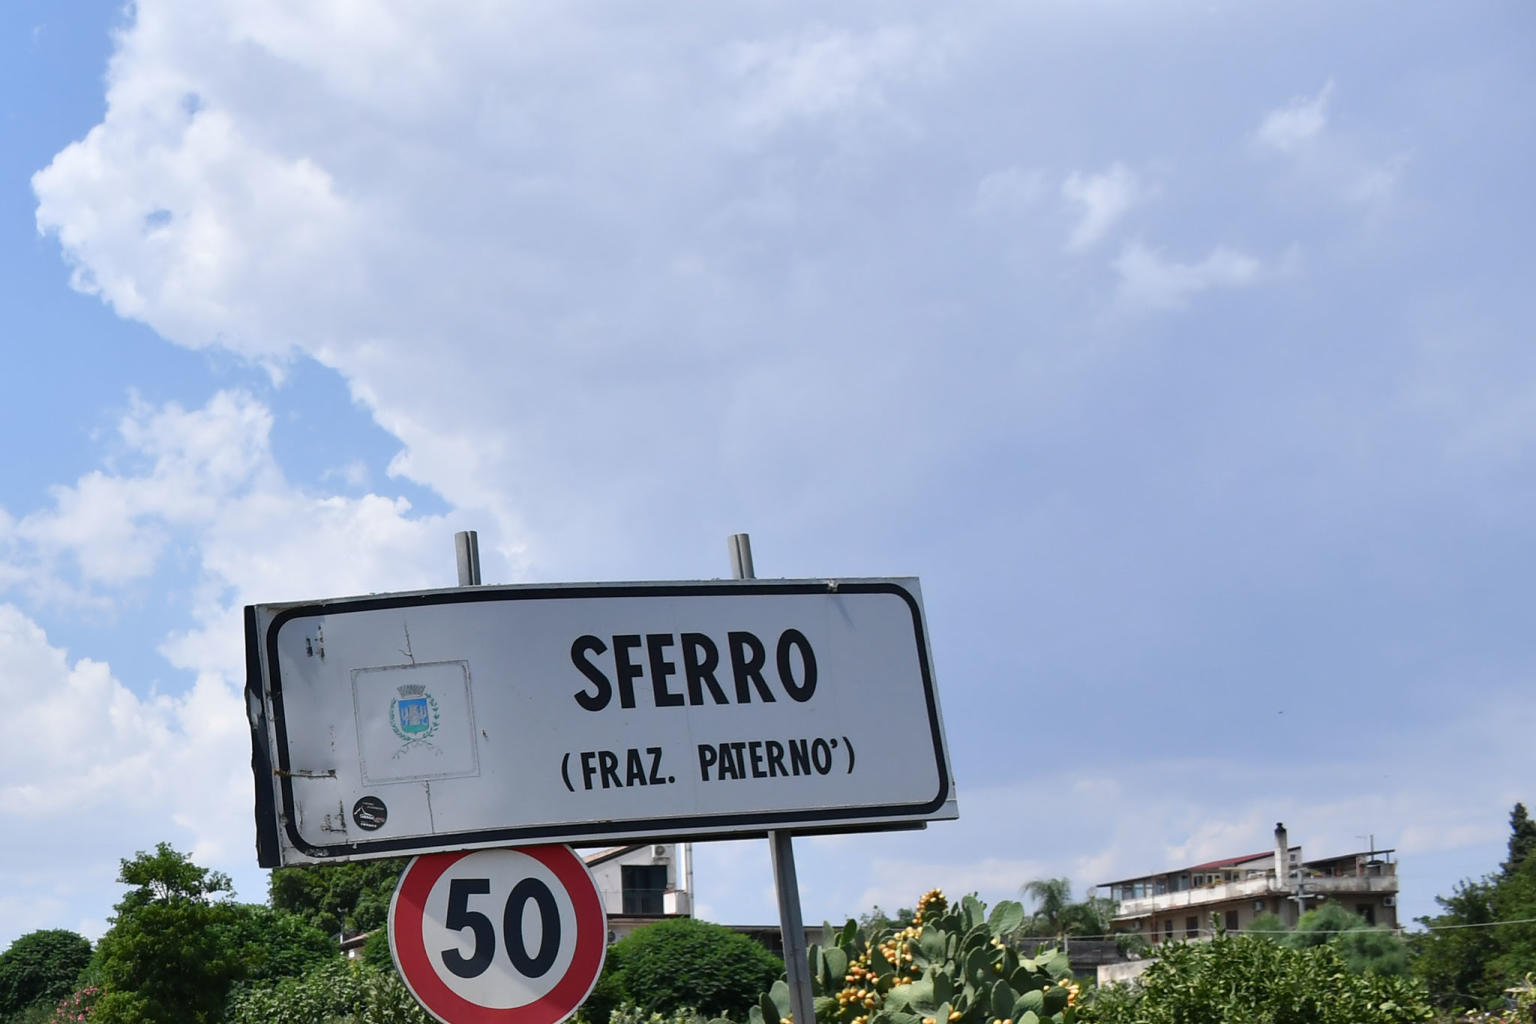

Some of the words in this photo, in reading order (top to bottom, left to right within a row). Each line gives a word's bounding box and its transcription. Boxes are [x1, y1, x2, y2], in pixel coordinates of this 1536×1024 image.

[570, 629, 818, 712] SFERRO
[561, 746, 676, 793] (FRAZ.
[697, 736, 856, 782] PATERNO')
[441, 877, 562, 979] 50
